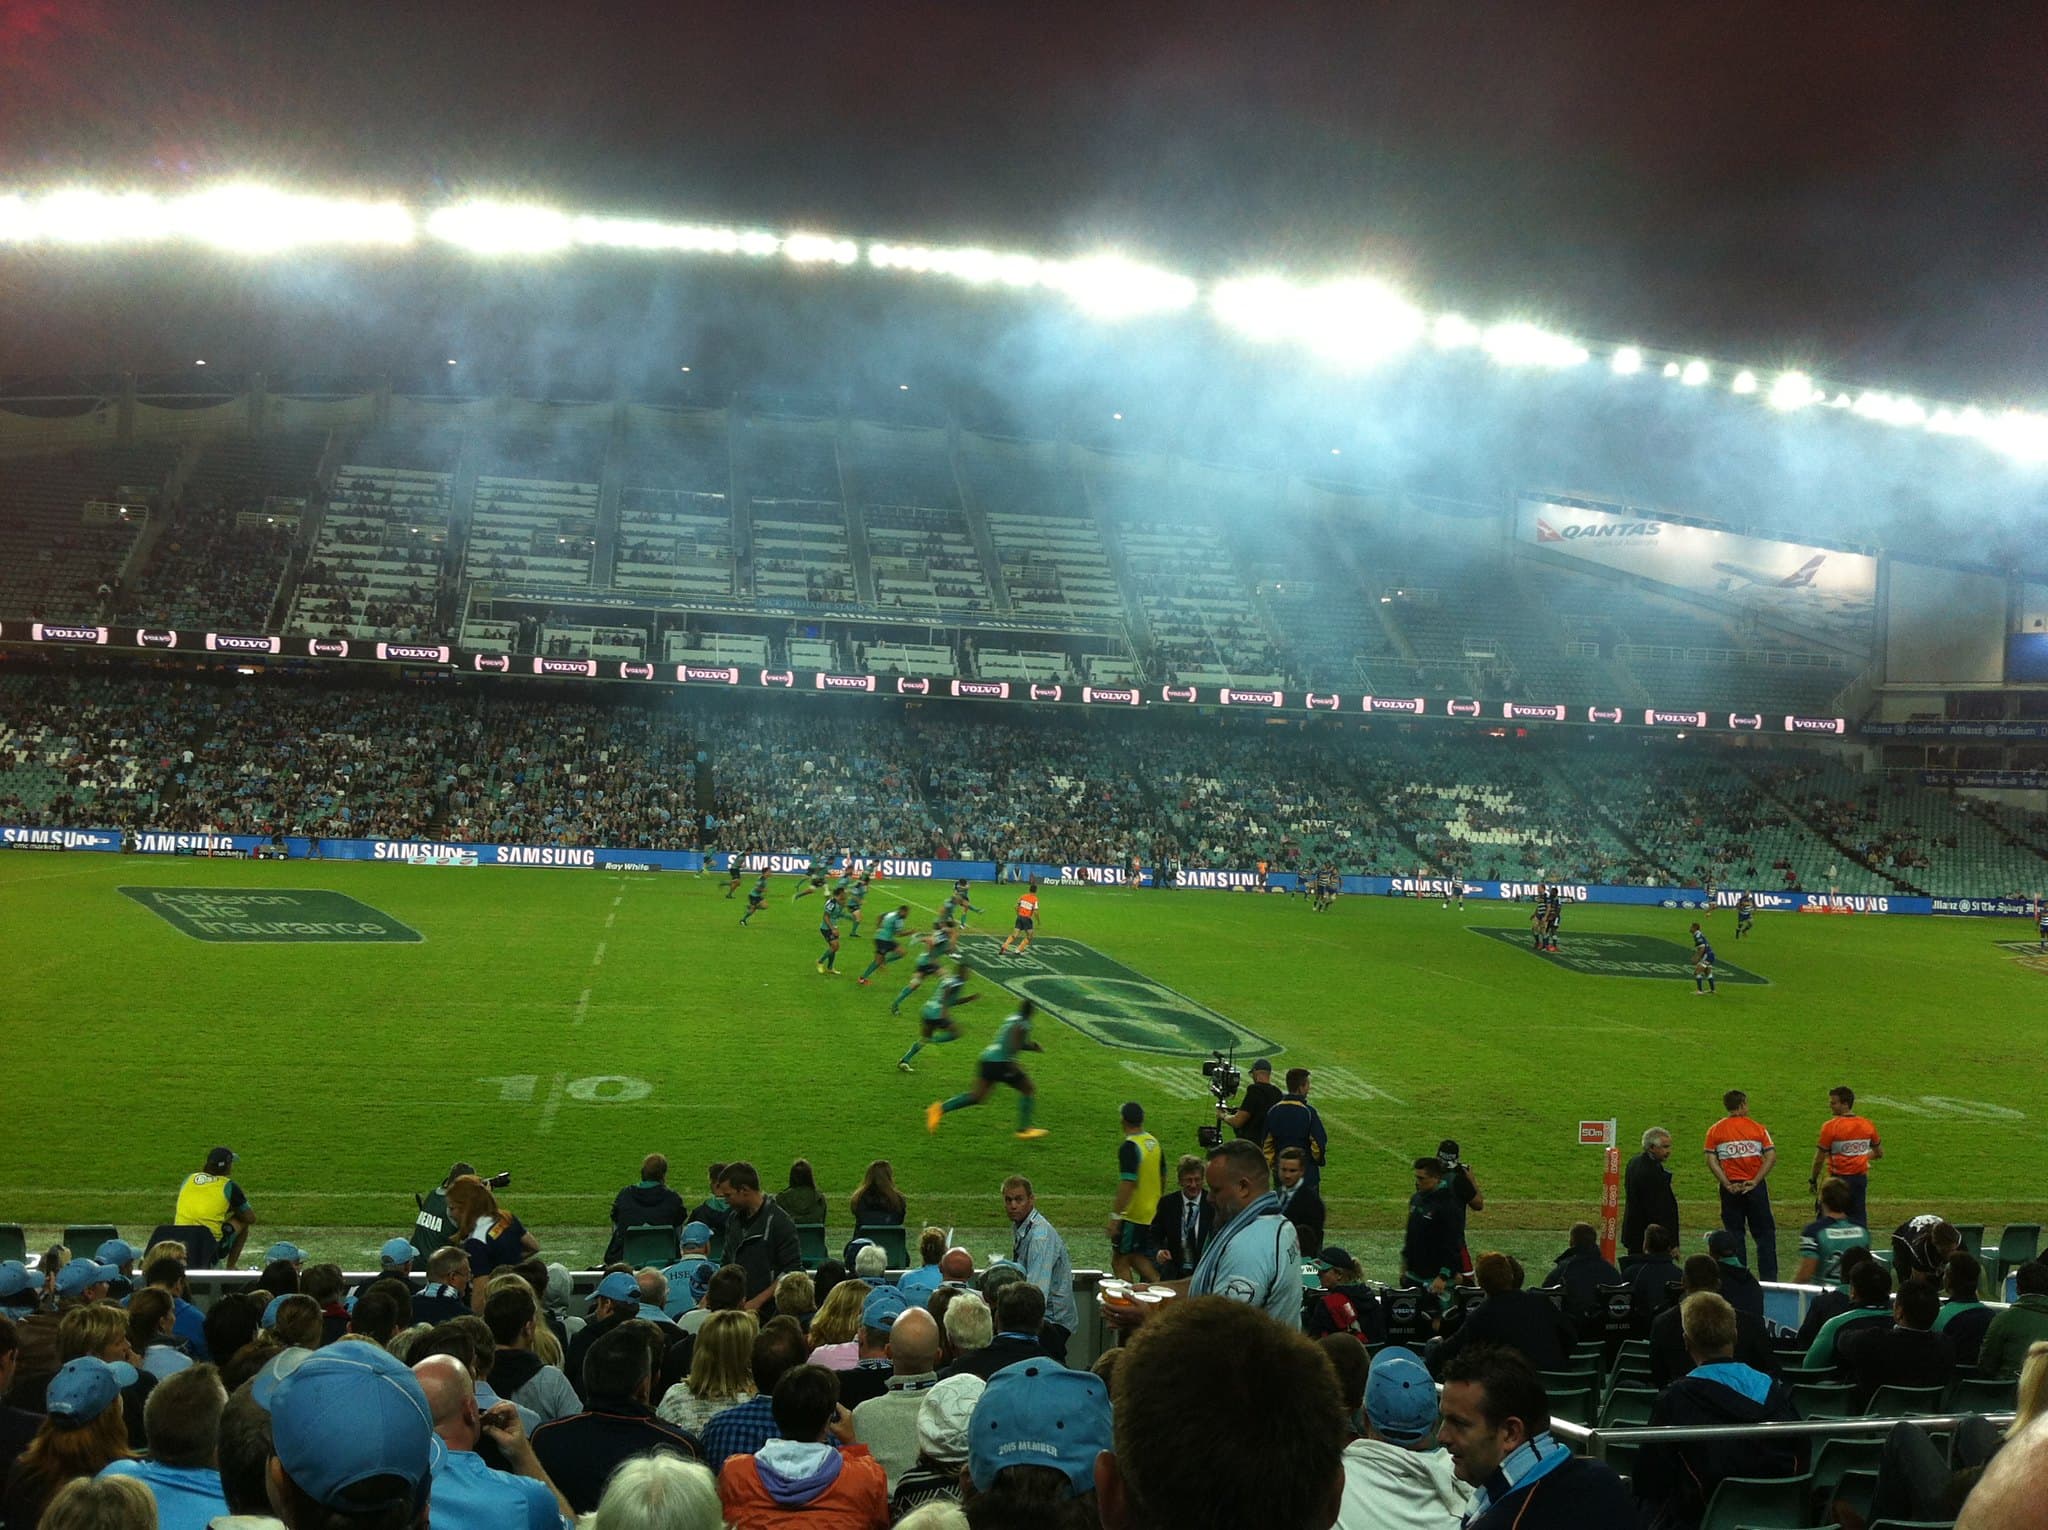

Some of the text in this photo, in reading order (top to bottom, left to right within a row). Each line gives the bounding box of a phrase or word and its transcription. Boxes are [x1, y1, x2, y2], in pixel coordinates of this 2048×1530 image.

[1561, 522, 1662, 539] QANTAS
[44, 628, 97, 640] VOLVO
[217, 638, 269, 649] VOLVO
[387, 647, 439, 658] VOLVO
[543, 662, 588, 672] VOLVO
[686, 670, 730, 680] VOLVO
[825, 678, 867, 687] VOLVO
[960, 685, 1000, 694] VOLVO
[1092, 691, 1131, 701] VOLVO
[1230, 693, 1273, 703] VOLVO
[1372, 700, 1415, 710] VOLVO
[1512, 707, 1556, 717] VOLVO
[1654, 713, 1698, 724] VOLVO
[1794, 720, 1836, 730] VOLVO
[1949, 726, 1984, 735] Allianz
[1998, 726, 2036, 736] Stadium
[497, 846, 595, 867] SAMSUNG
[605, 862, 650, 872] Ray White
[727, 854, 810, 873] SMSUN
[1500, 883, 1587, 901] SAMSNG
[153, 892, 302, 905] Asteron
[1807, 895, 1888, 912] SAMSUNG
[162, 903, 248, 918] Life
[192, 918, 387, 935] Insurance
[479, 1074, 652, 1102] 10
[998, 1439, 1059, 1457] 2015 MEMBER
